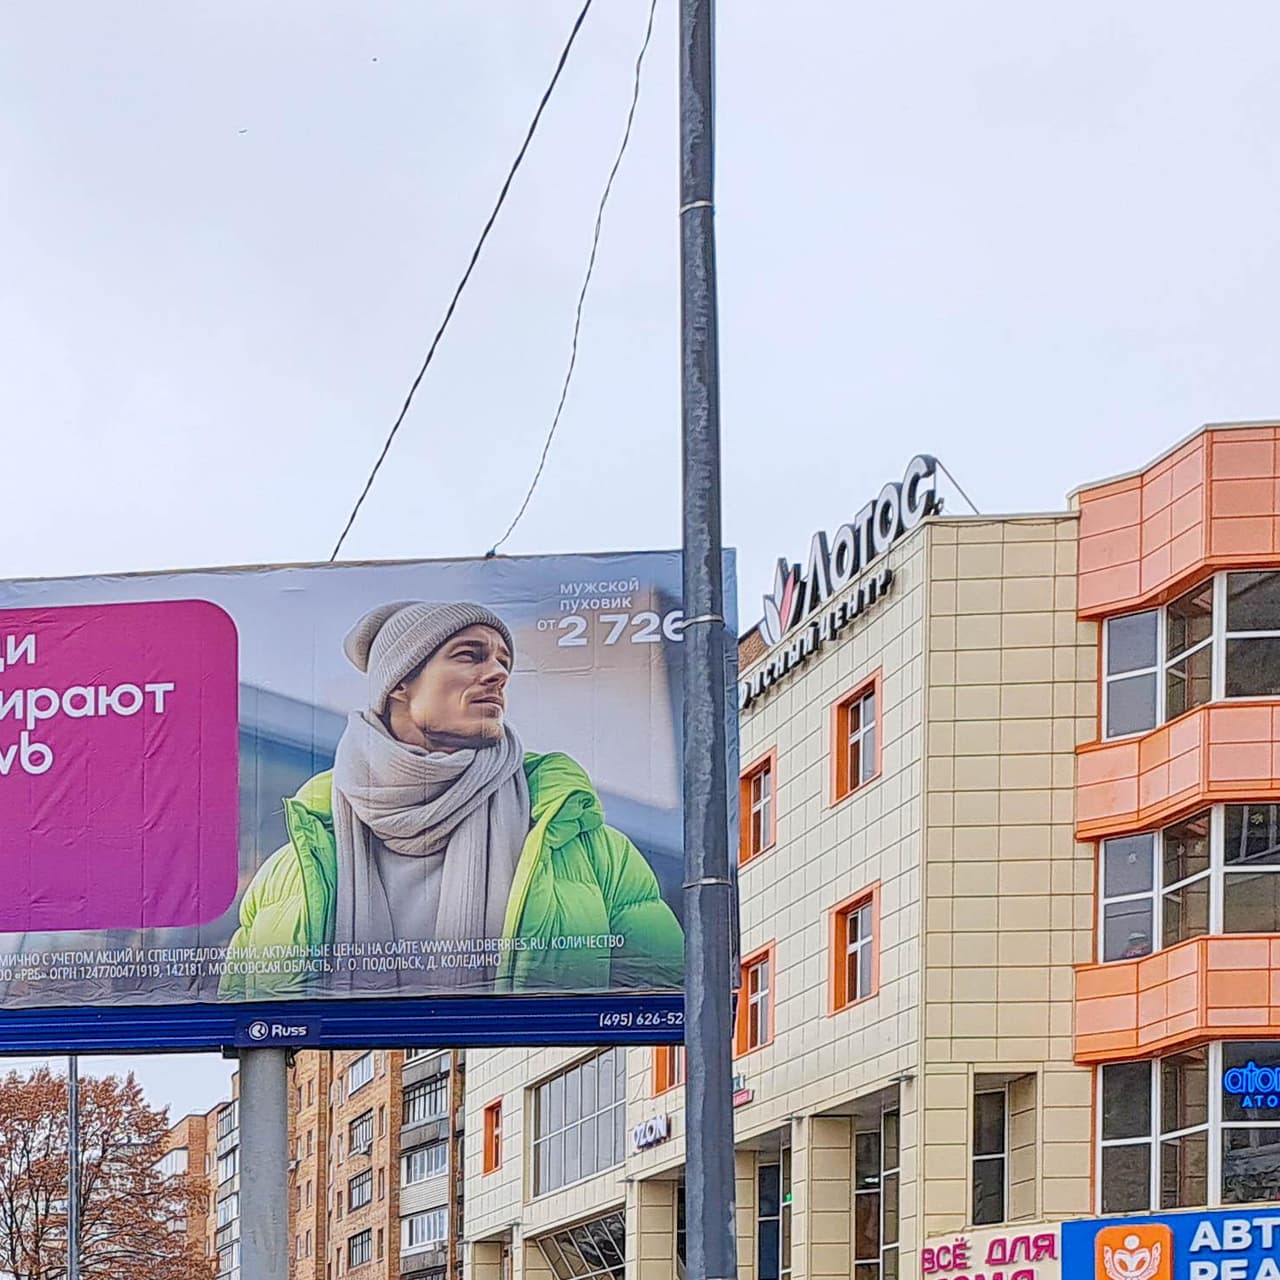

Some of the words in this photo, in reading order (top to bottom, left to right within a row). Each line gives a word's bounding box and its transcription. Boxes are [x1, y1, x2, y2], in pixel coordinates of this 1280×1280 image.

[802, 454, 936, 620] ЛОТОС
[559, 576, 640, 596] мужской
[559, 595, 633, 614] пуховик
[818, 568, 893, 645] ЦЕНТР
[536, 618, 556, 632] от
[42, 954, 50, 966] С
[51, 951, 95, 966] УЧЕТОМ
[96, 947, 133, 965] АКЦИЙ
[136, 951, 145, 963] И
[148, 945, 260, 963] СПЕЦПРЕДЛОЖЕНИЙ.
[262, 943, 330, 959] АКТУАЛЬНЫЕ
[332, 942, 365, 958] ЦЕНЫ
[367, 942, 382, 956] НА
[384, 937, 419, 955] САЙТЕ
[421, 935, 549, 954] WWW.WILDBERRIES.RU.
[551, 934, 625, 950] КОЛИЧЕСТВО
[49, 967, 78, 981] ОГРН
[165, 963, 206, 977] 142181,
[208, 960, 282, 975] МОСКОВСКАЯ
[283, 958, 334, 974] ОБЛАСТЬ,
[348, 958, 360, 971] О.
[362, 955, 425, 971] ПОДОЛЬСК,
[426, 955, 439, 970] Д.
[441, 953, 503, 968] КОЛЕДИНО
[271, 1023, 308, 1038] Russ
[599, 1012, 633, 1028] (495)
[636, 1012, 686, 1026] 626-52
[632, 1113, 672, 1150] OZON
[921, 1237, 972, 1274] ВСЁ
[985, 1233, 1058, 1265] ДЛЯ
